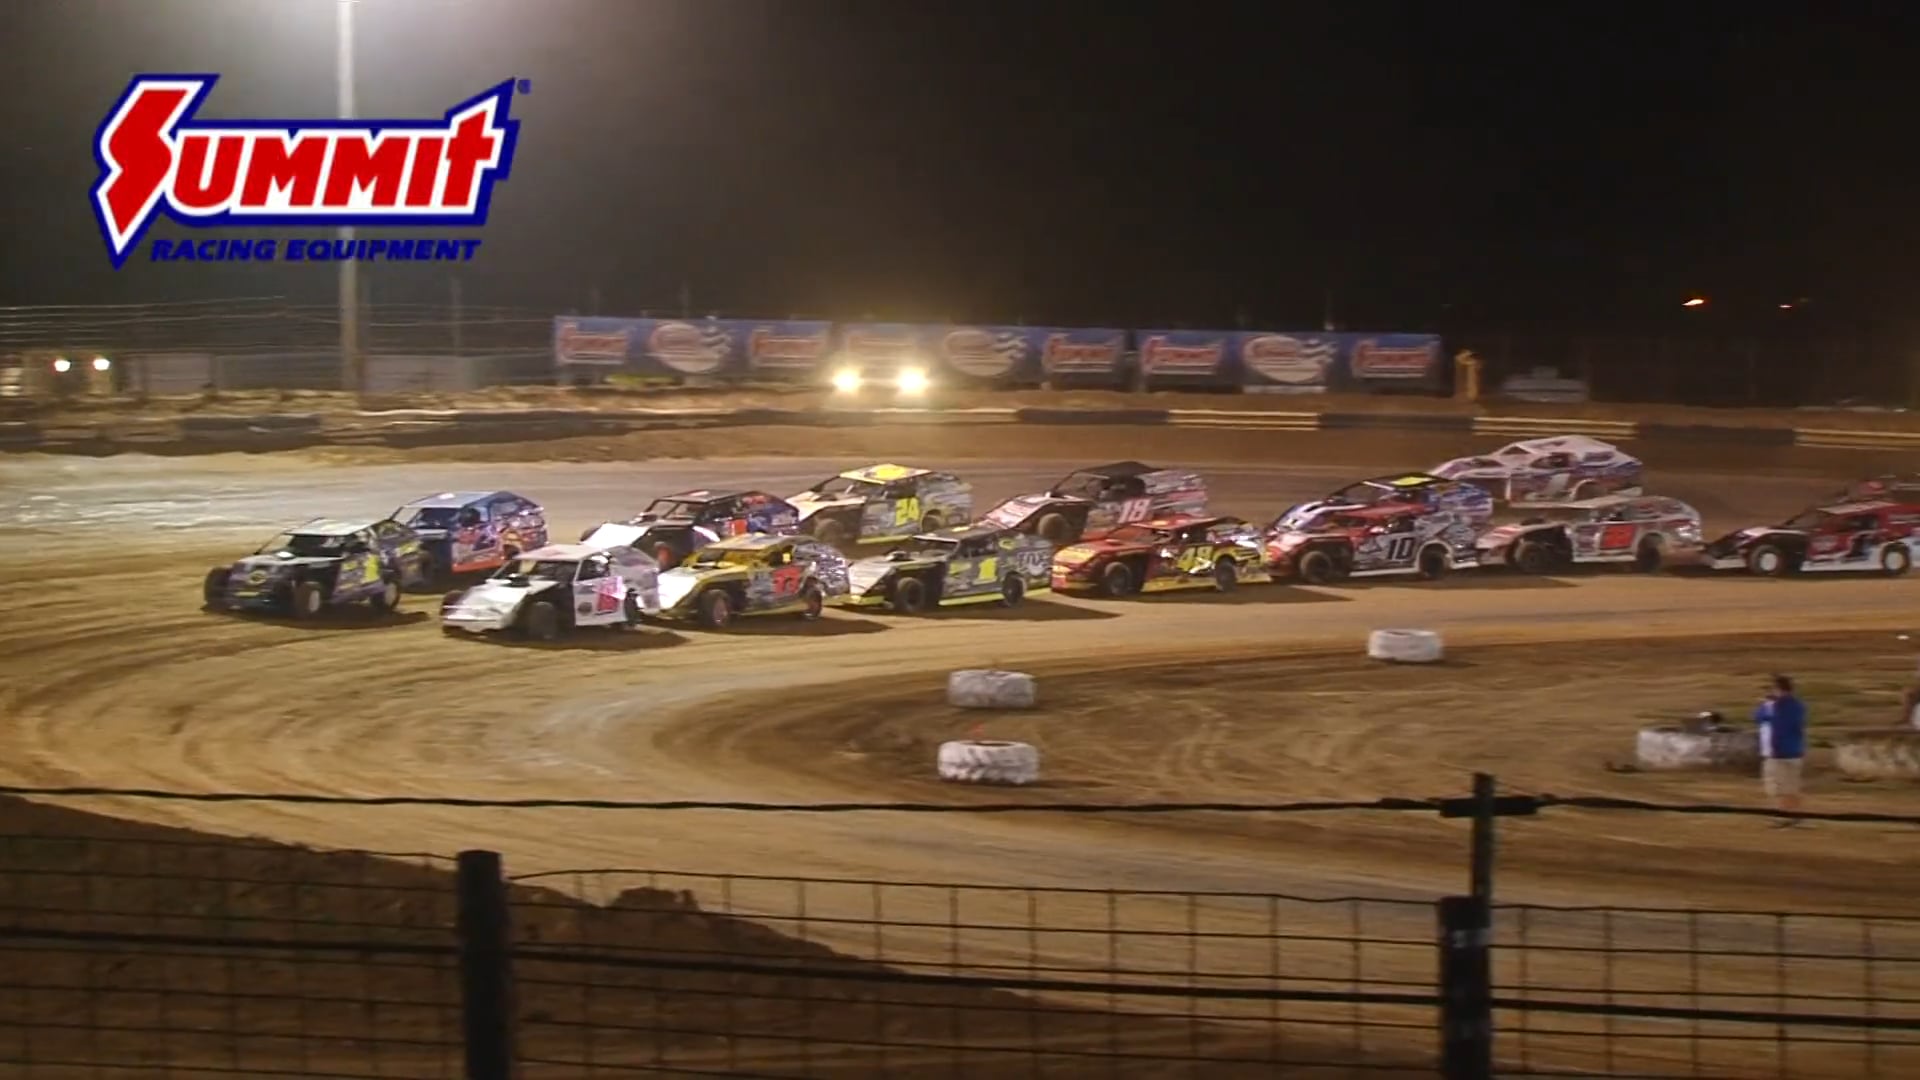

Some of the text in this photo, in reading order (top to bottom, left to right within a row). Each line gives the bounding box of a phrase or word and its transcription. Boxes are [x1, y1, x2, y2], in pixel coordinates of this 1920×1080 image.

[895, 496, 920, 527] 24
[1118, 498, 1151, 524] 18
[1385, 537, 1415, 561] 10
[978, 558, 999, 580] 1
